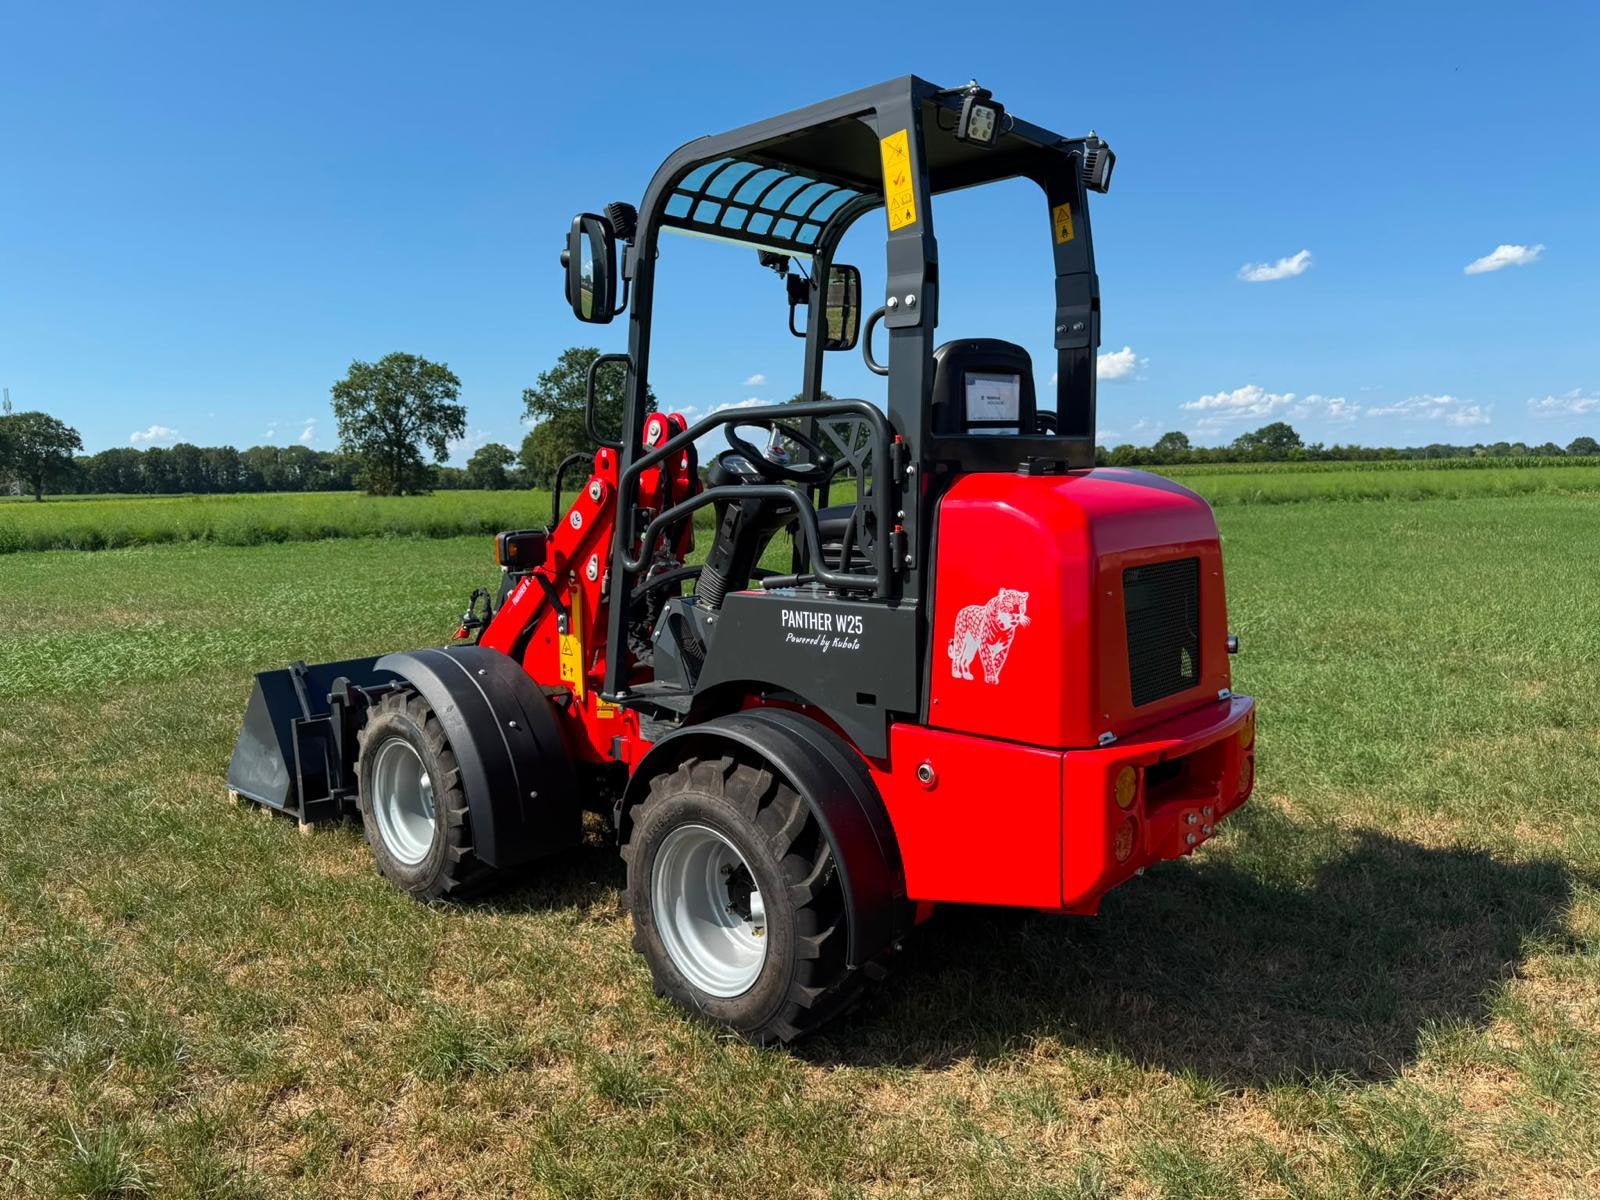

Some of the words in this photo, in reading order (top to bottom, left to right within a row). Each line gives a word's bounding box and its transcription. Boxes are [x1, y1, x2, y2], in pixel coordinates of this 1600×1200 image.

[781, 609, 832, 631] PANTHER
[836, 614, 863, 634] W25
[785, 632, 821, 645] Powered
[820, 634, 831, 653] by
[832, 637, 860, 650] Kubota
